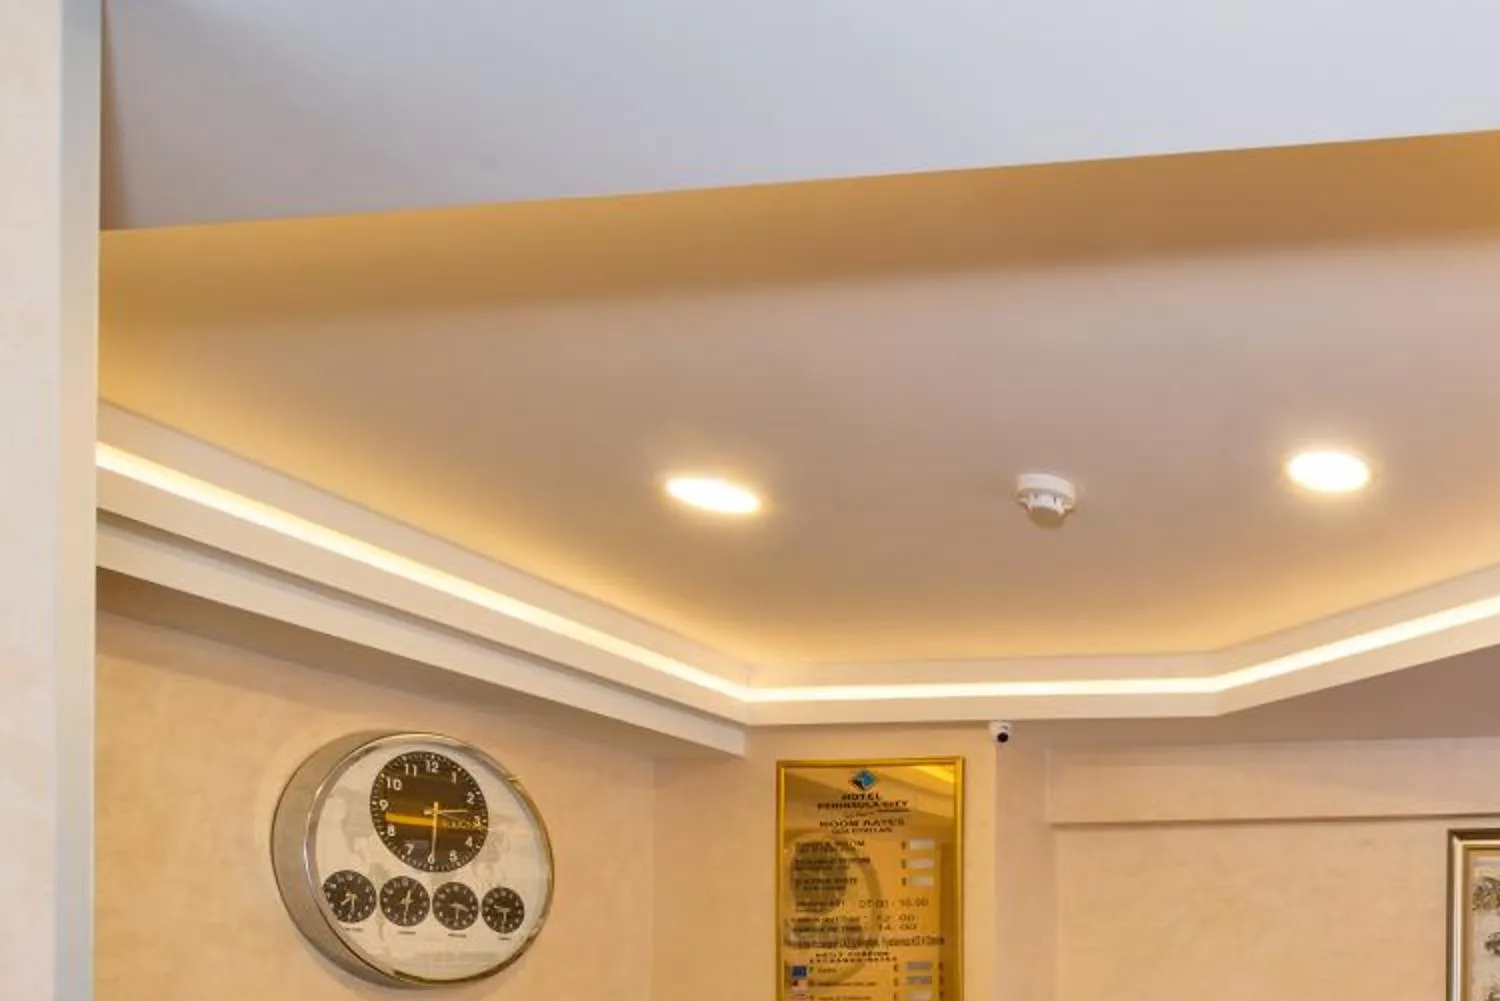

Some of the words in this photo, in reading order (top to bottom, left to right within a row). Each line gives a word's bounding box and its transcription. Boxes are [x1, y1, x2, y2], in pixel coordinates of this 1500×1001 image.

[403, 763, 418, 777] 11
[425, 759, 440, 774] 12
[451, 770, 458, 784] 1
[386, 777, 402, 791] 10
[466, 792, 475, 805] 2
[841, 793, 879, 801] HOTEL
[379, 799, 389, 811] 9
[387, 824, 396, 837] 8
[465, 836, 474, 848] 4
[405, 843, 415, 855] 7
[427, 853, 436, 865] 6
[449, 849, 458, 863] 5
